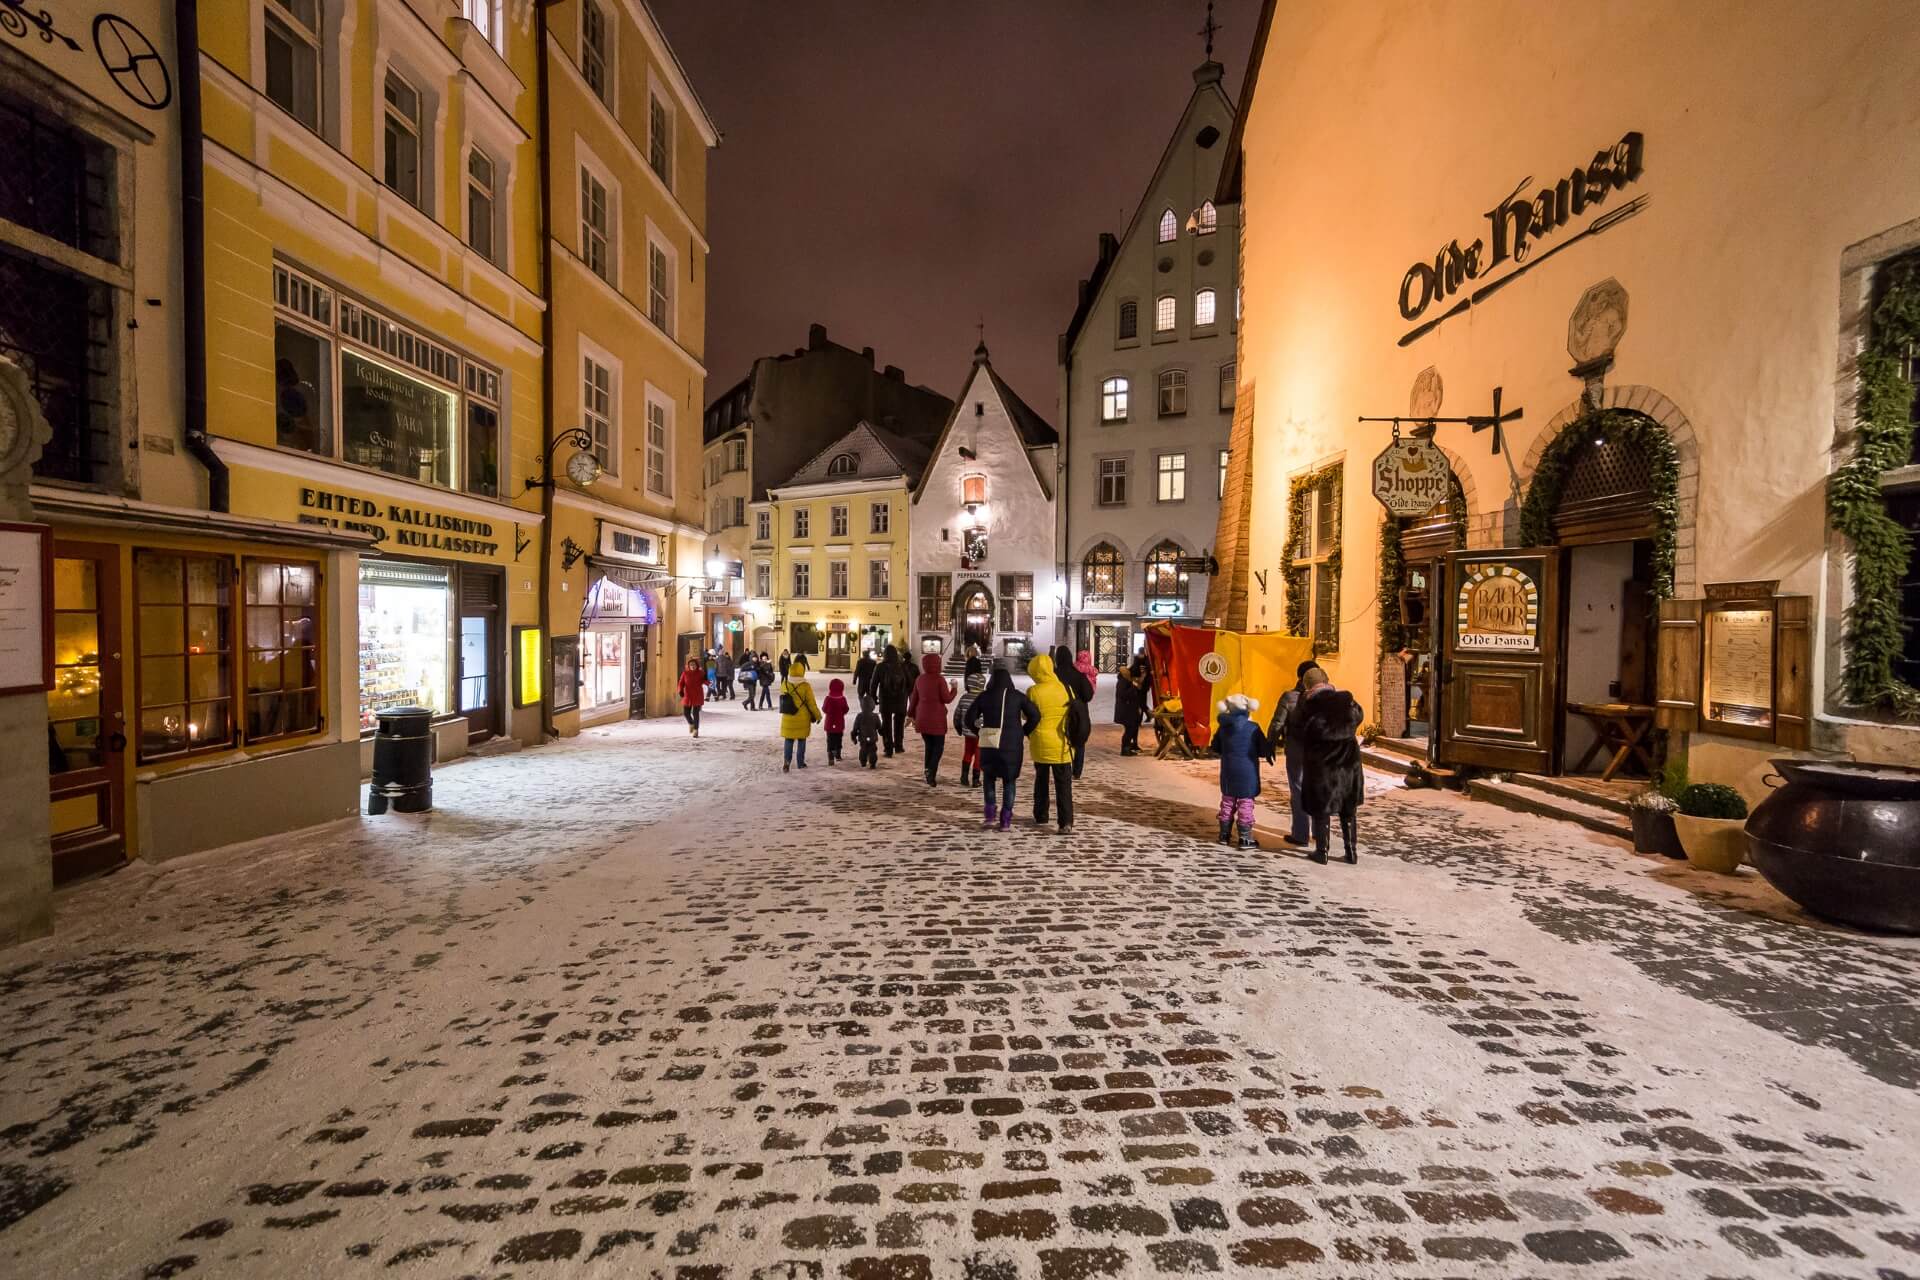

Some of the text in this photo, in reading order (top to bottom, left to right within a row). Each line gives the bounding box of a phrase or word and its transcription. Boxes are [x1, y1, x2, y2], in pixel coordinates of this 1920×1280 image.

[1398, 131, 1644, 321] Olde Hansa
[1378, 465, 1444, 498] Shoppe
[1389, 497, 1408, 508] Olde
[388, 504, 493, 538] KALLISKIVID
[397, 528, 499, 557] KULLASSEPP
[602, 600, 623, 612] Amber
[1478, 585, 1527, 607] BACK
[1478, 605, 1525, 627] DOOR
[1462, 633, 1490, 645] Olde
